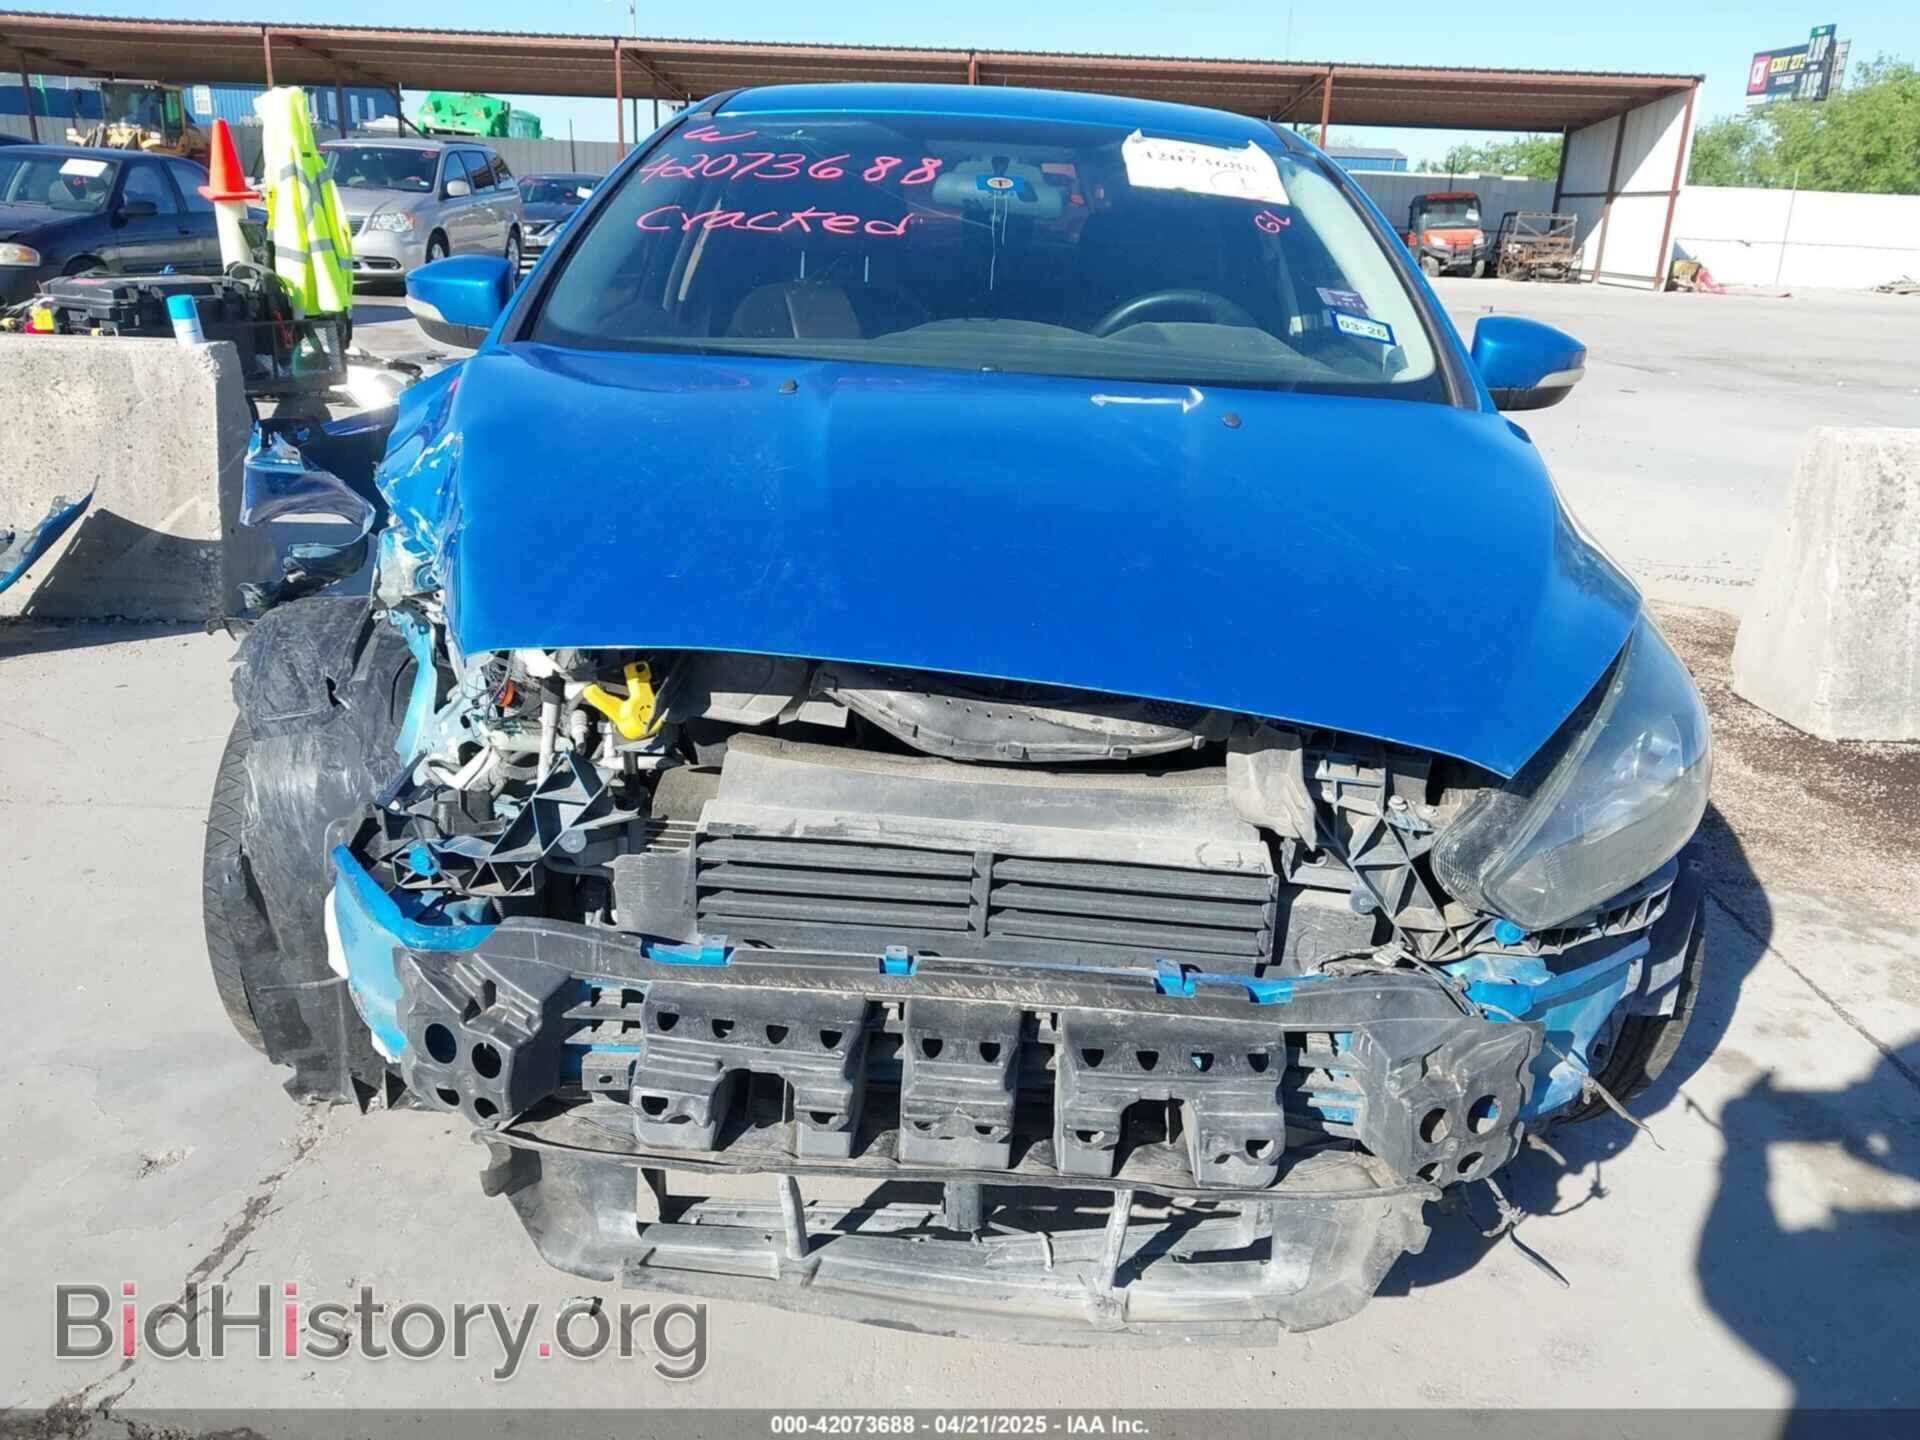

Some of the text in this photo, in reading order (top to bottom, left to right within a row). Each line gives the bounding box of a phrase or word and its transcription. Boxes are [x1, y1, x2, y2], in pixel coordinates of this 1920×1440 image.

[1769, 56, 1791, 73] EXIT
[640, 151, 943, 185] 42073688
[1340, 319, 1386, 338] 03-26
